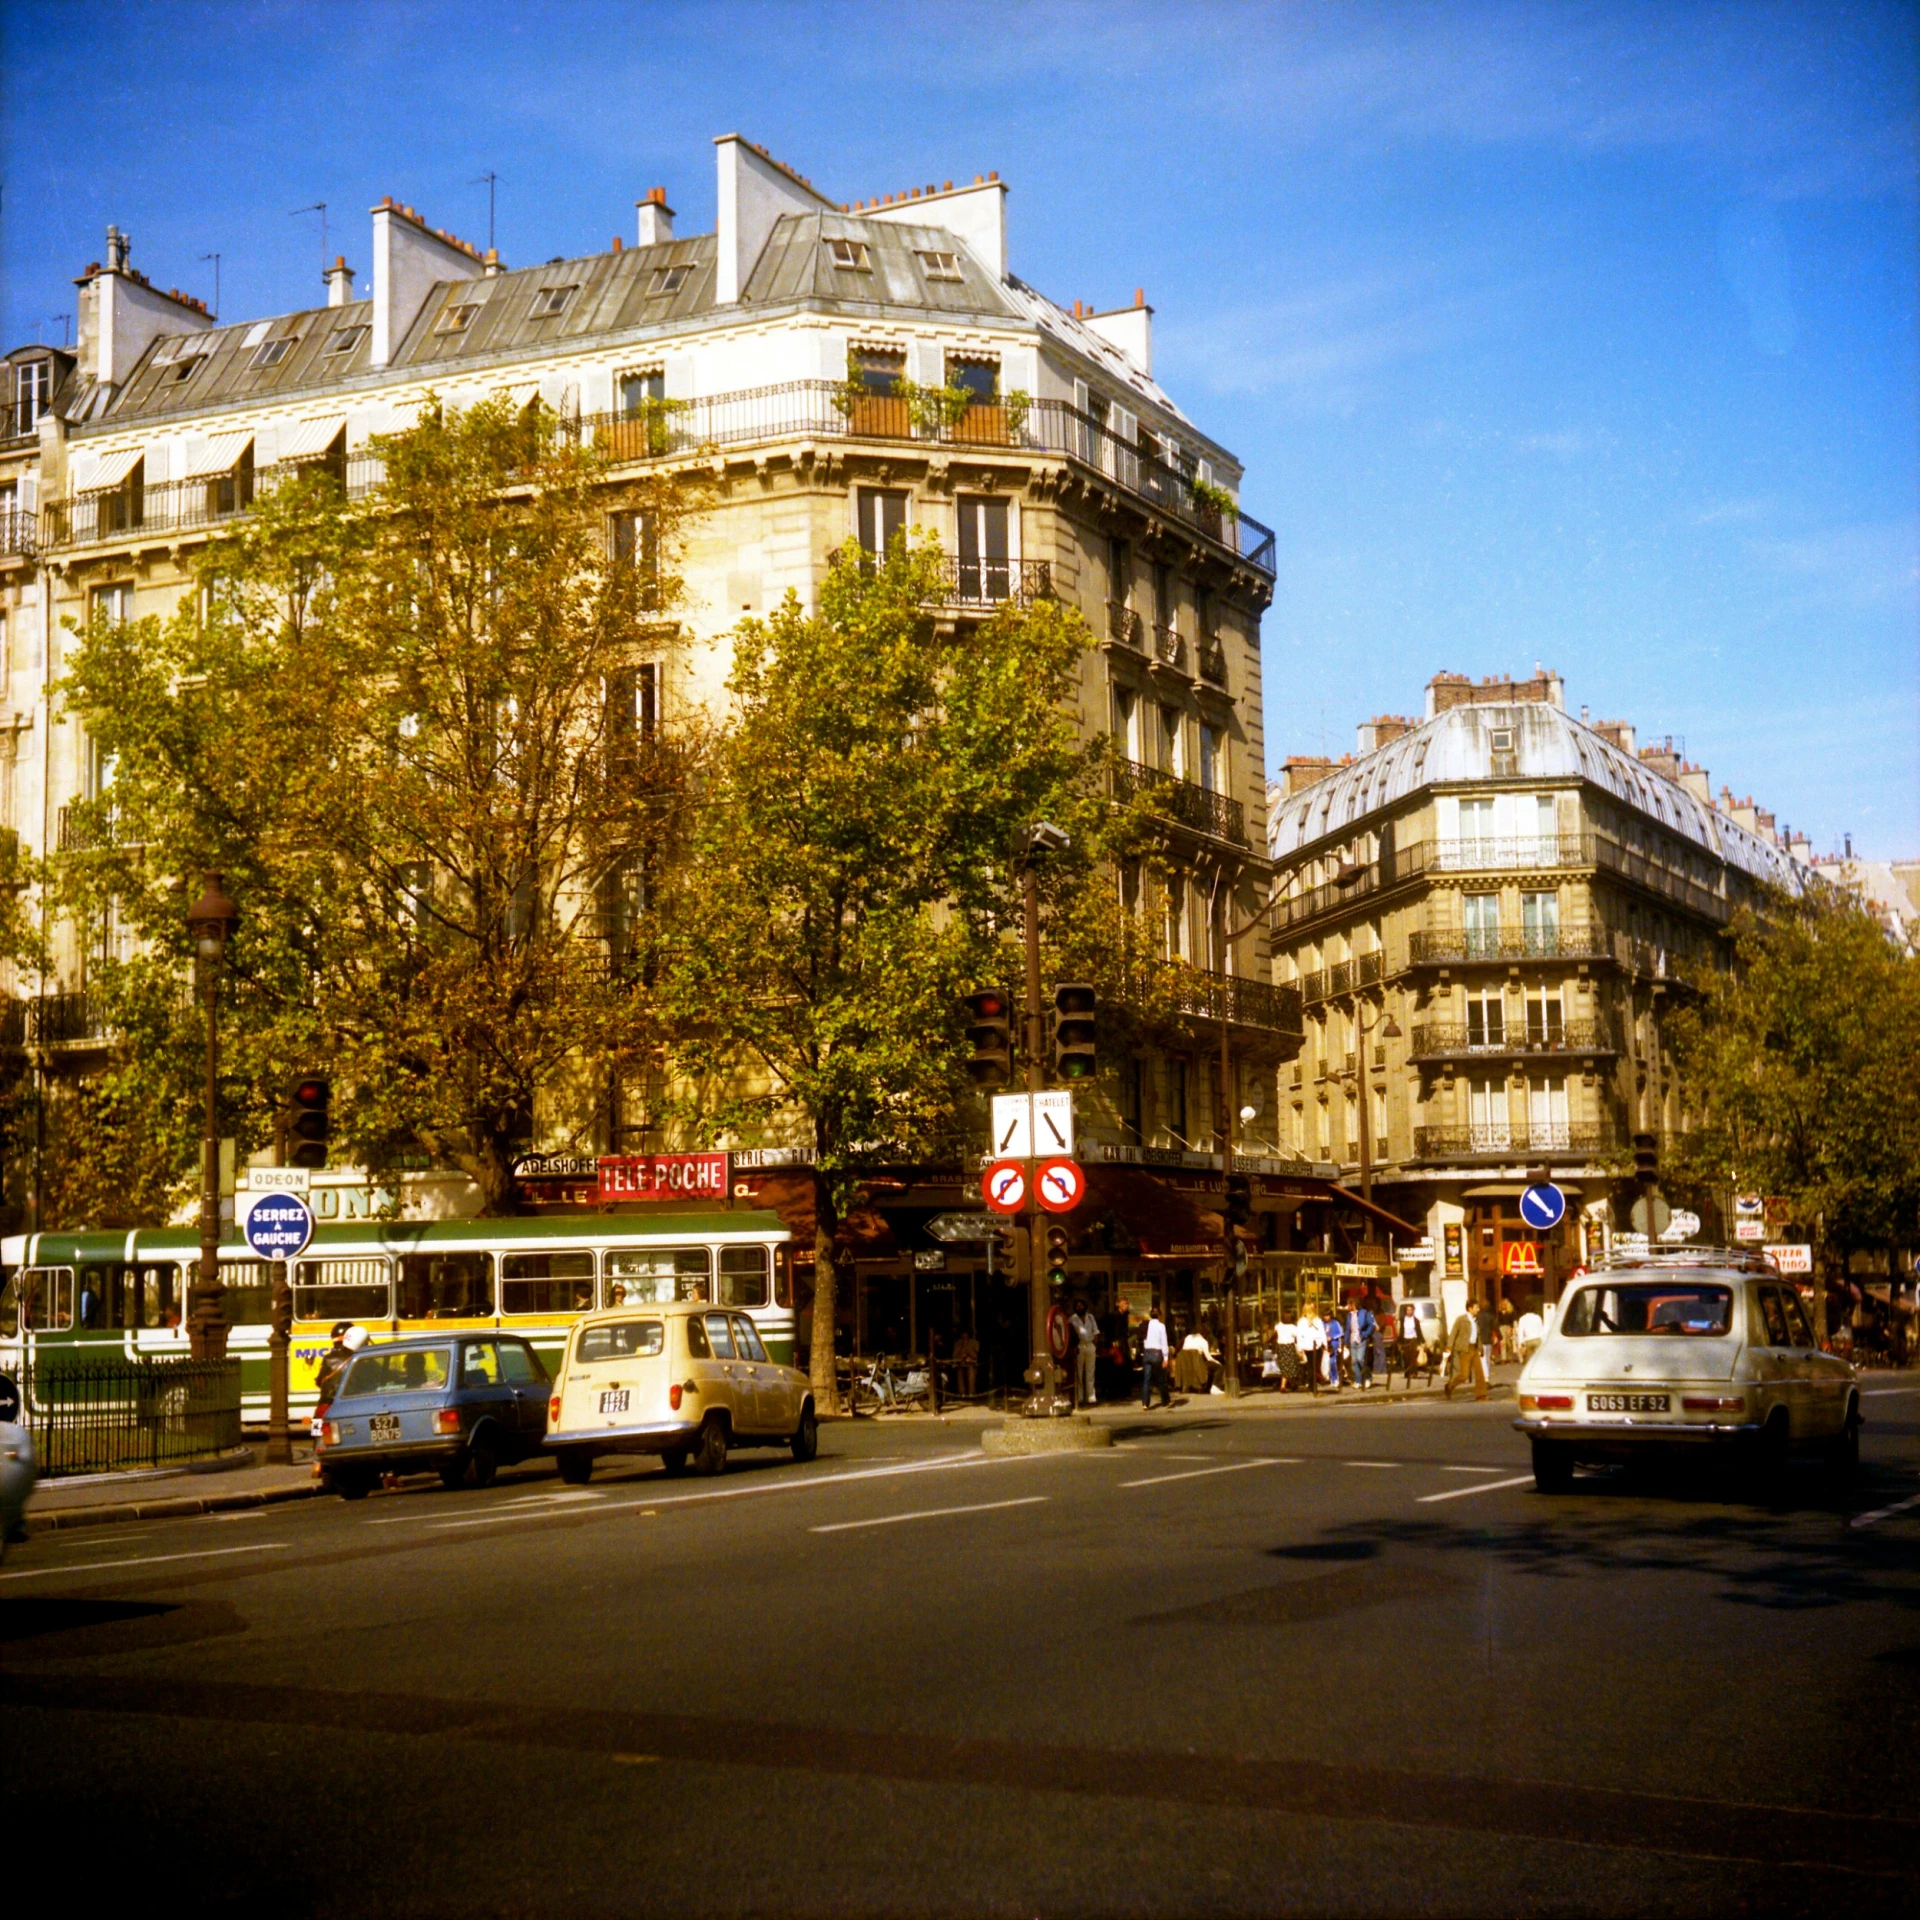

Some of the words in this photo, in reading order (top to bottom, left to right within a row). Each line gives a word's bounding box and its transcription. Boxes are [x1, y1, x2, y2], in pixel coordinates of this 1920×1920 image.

[735, 1150, 764, 1165] SERIE
[1142, 1149, 1182, 1165] ADELSHOFFEN
[255, 1174, 304, 1186] ODEON
[1195, 1180, 1206, 1192] LE
[253, 1208, 305, 1222] SERREZ
[253, 1231, 302, 1246] GAUCHE
[1592, 1396, 1625, 1410] 6069
[1630, 1396, 1646, 1410] EF
[1649, 1396, 1666, 1411] 92
